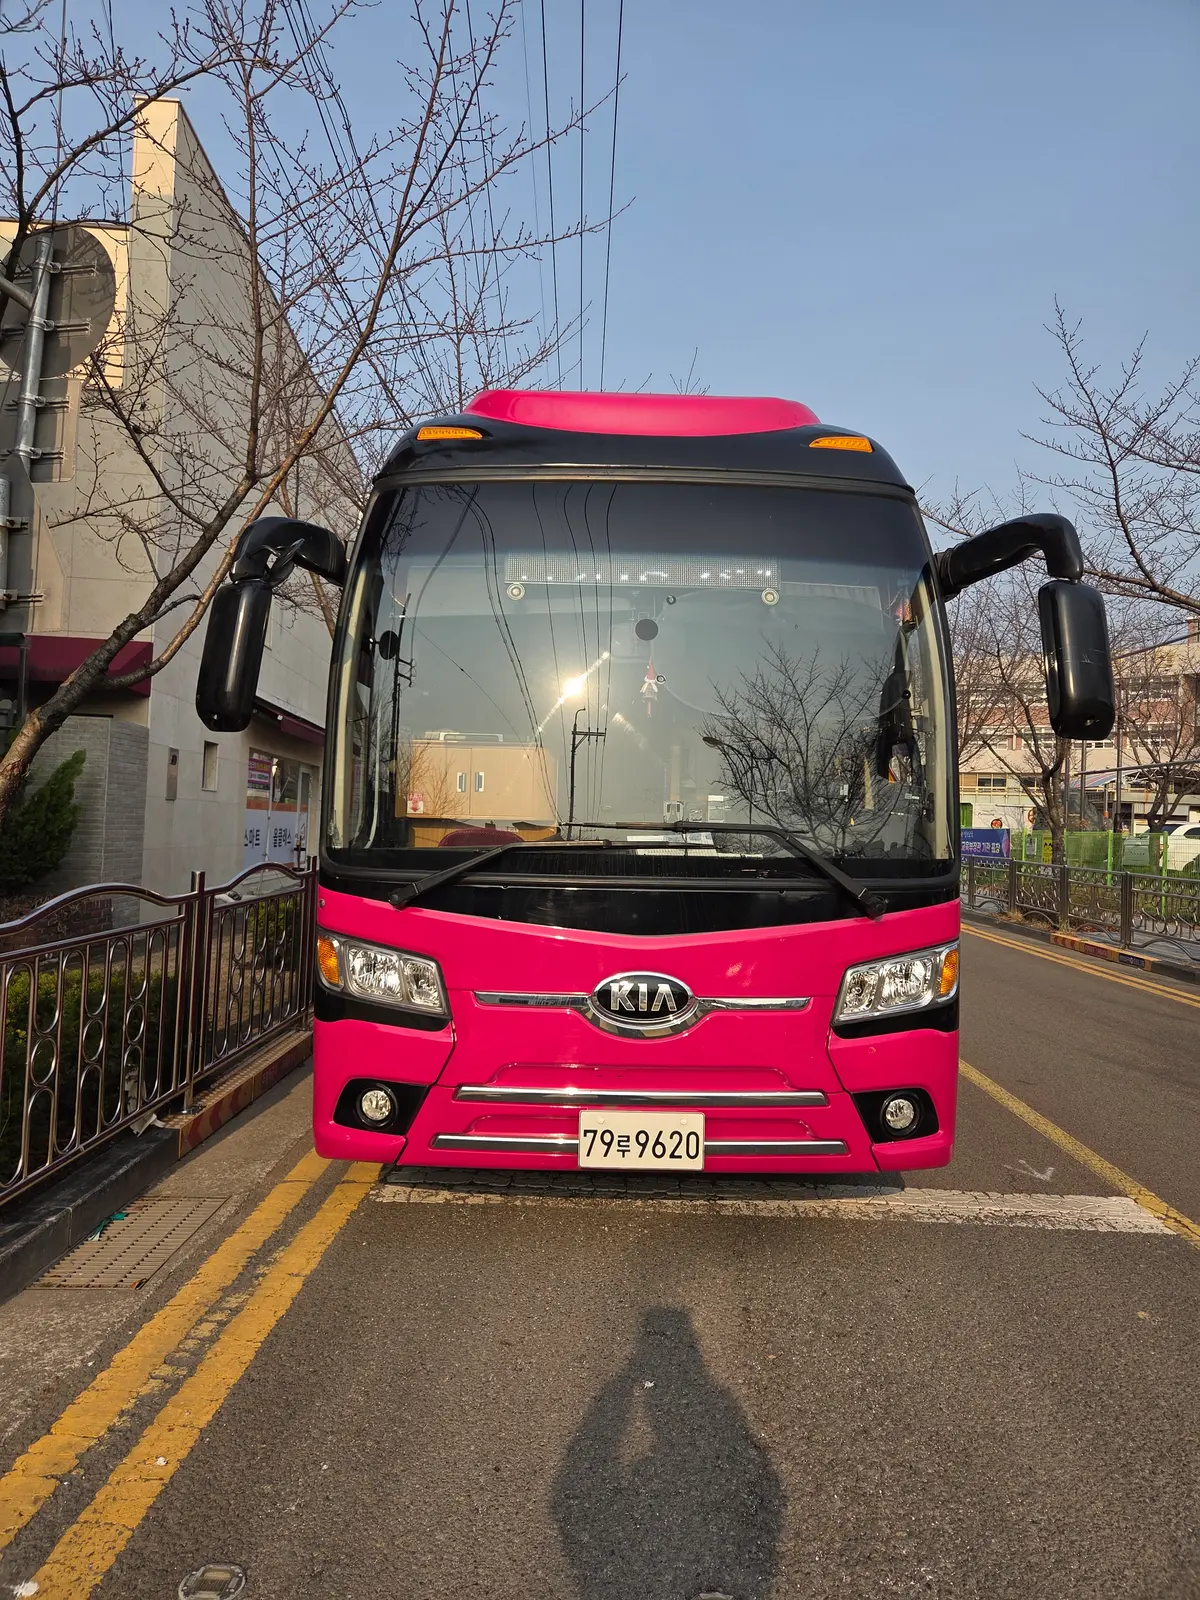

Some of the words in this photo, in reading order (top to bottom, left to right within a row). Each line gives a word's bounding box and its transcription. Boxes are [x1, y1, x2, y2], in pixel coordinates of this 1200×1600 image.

[244, 828, 261, 849] 스마트
[609, 981, 678, 1012] KIA
[583, 1129, 700, 1160] 79루9620
